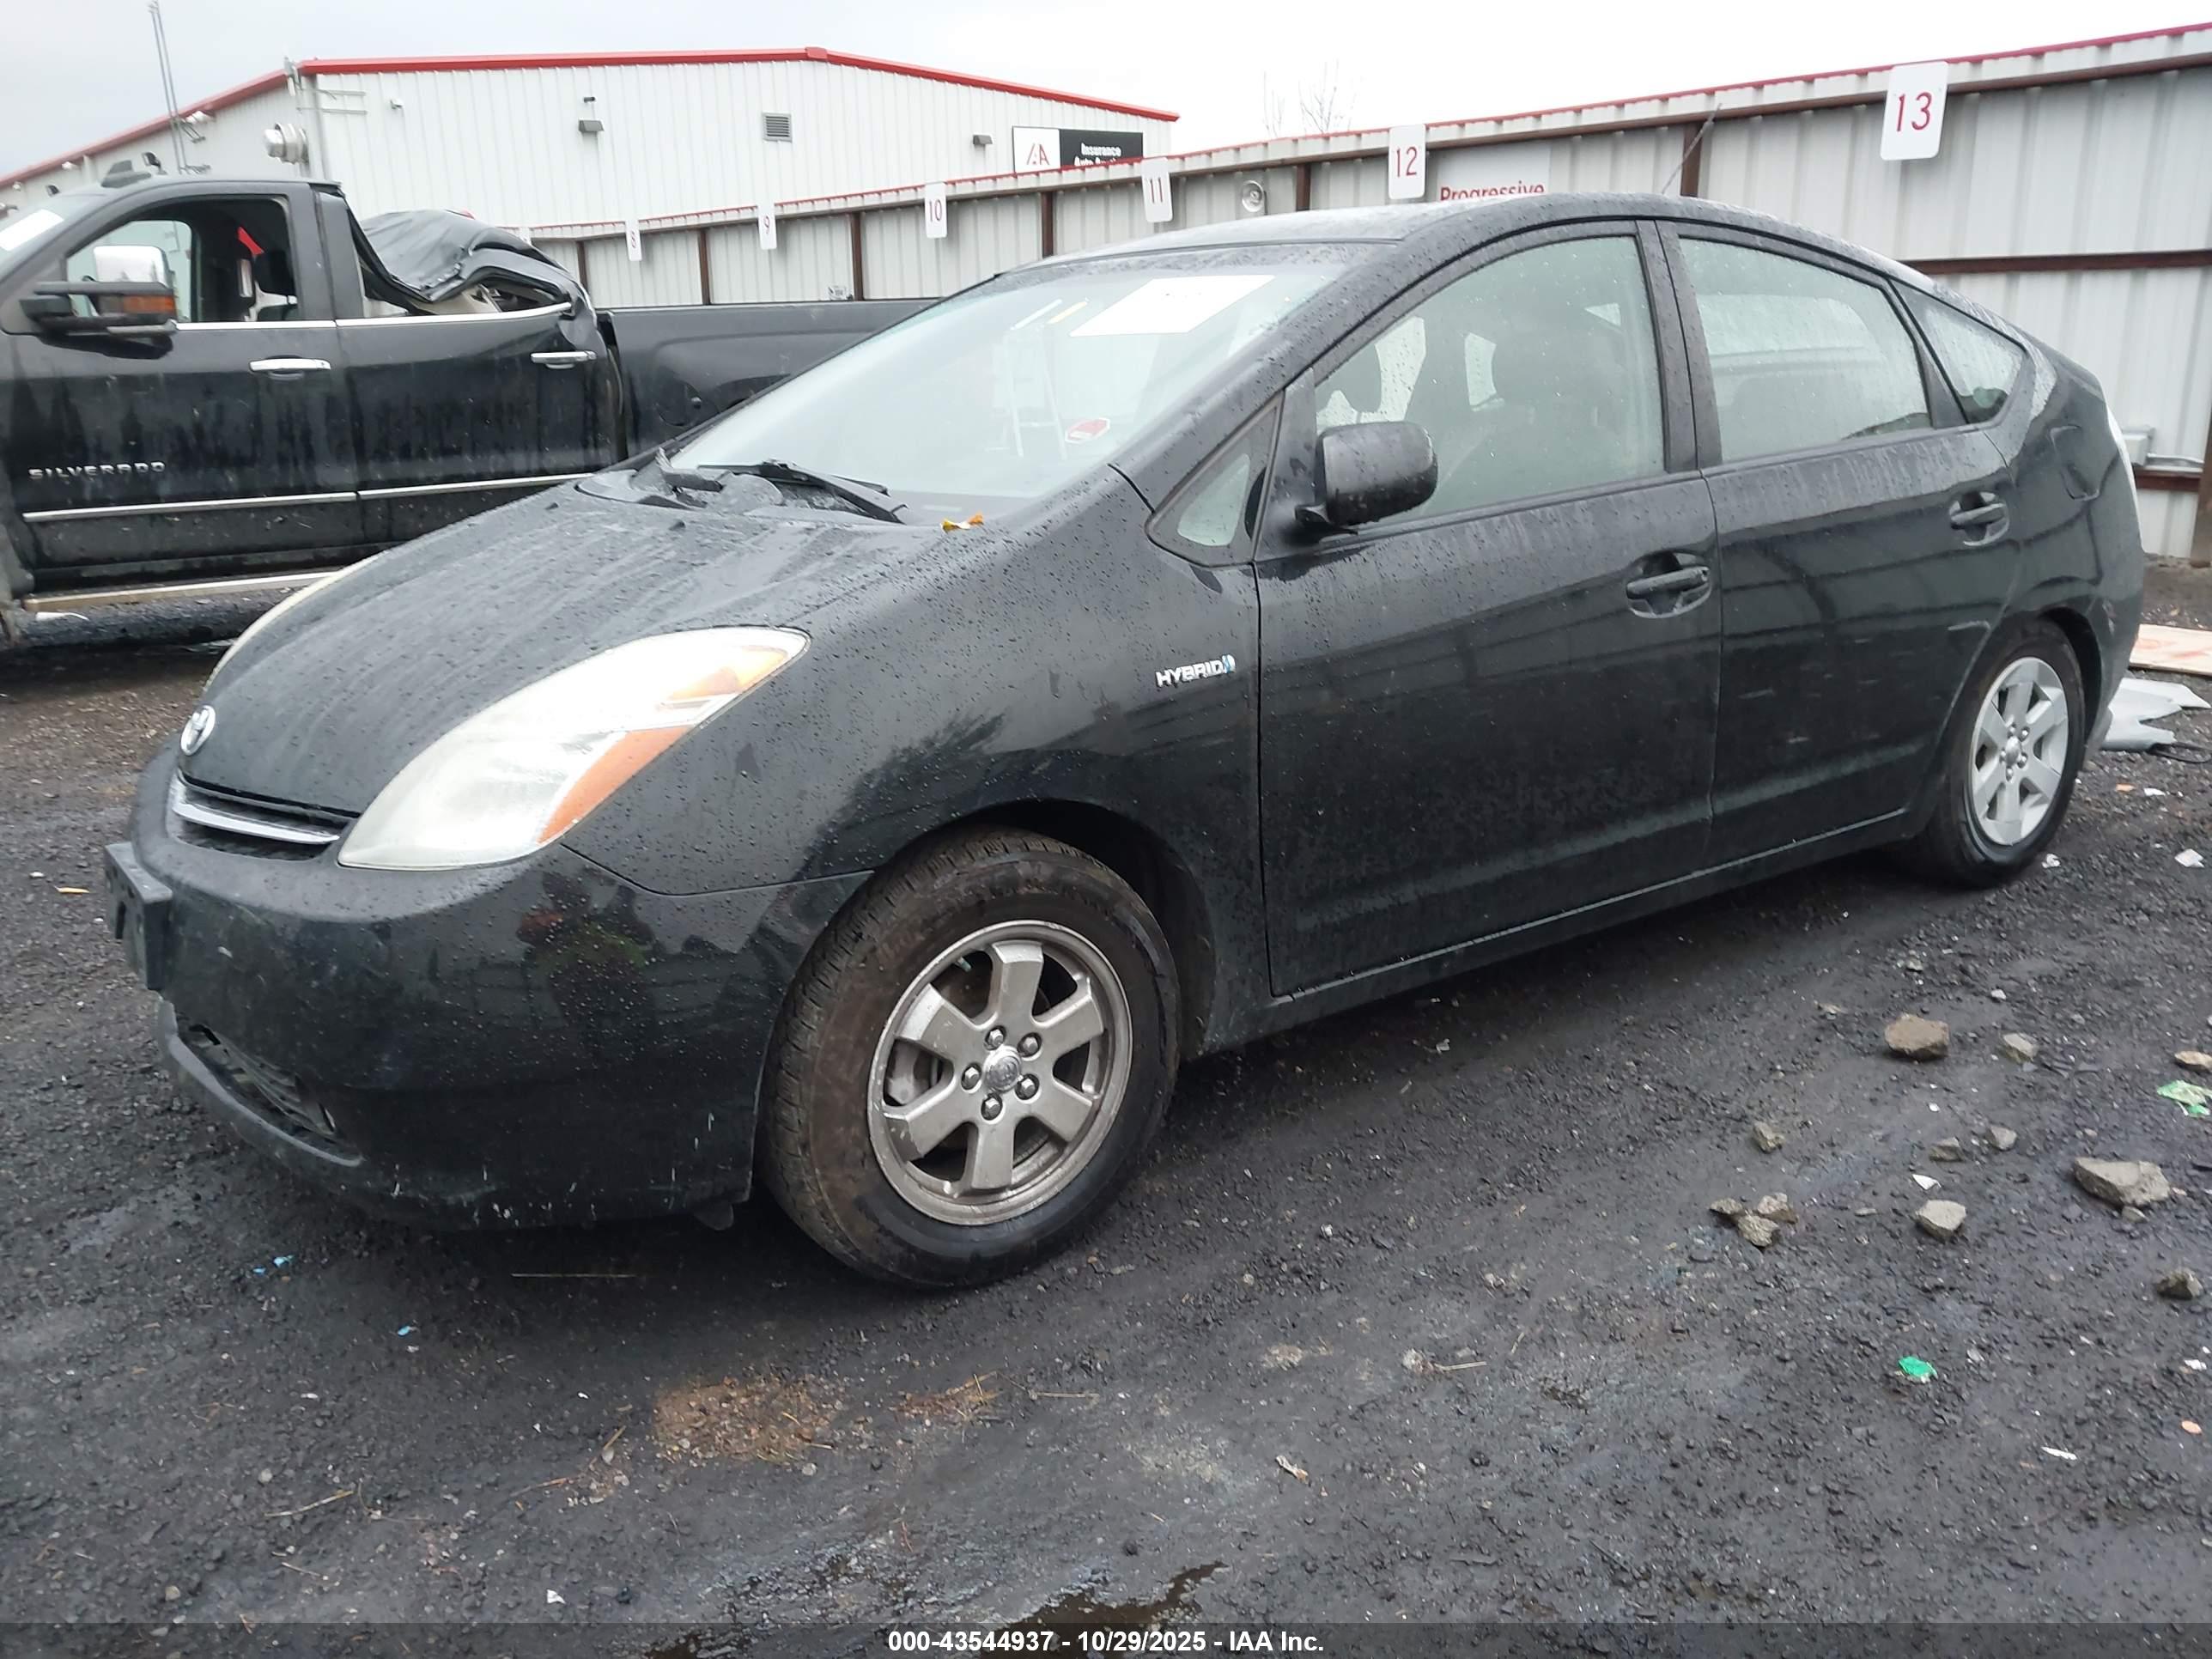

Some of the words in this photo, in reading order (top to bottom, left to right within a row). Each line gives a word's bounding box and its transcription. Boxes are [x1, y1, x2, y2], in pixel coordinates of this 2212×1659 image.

[1896, 91, 1933, 132] 13
[1081, 143, 1121, 156] Insurance
[1396, 146, 1418, 178] 12
[1150, 177, 1164, 204] 11
[928, 198, 943, 222] 10
[763, 215, 771, 235] 9
[629, 228, 637, 250] 8
[27, 460, 166, 480] SILVERADO
[1154, 659, 1224, 688] HYBRID
